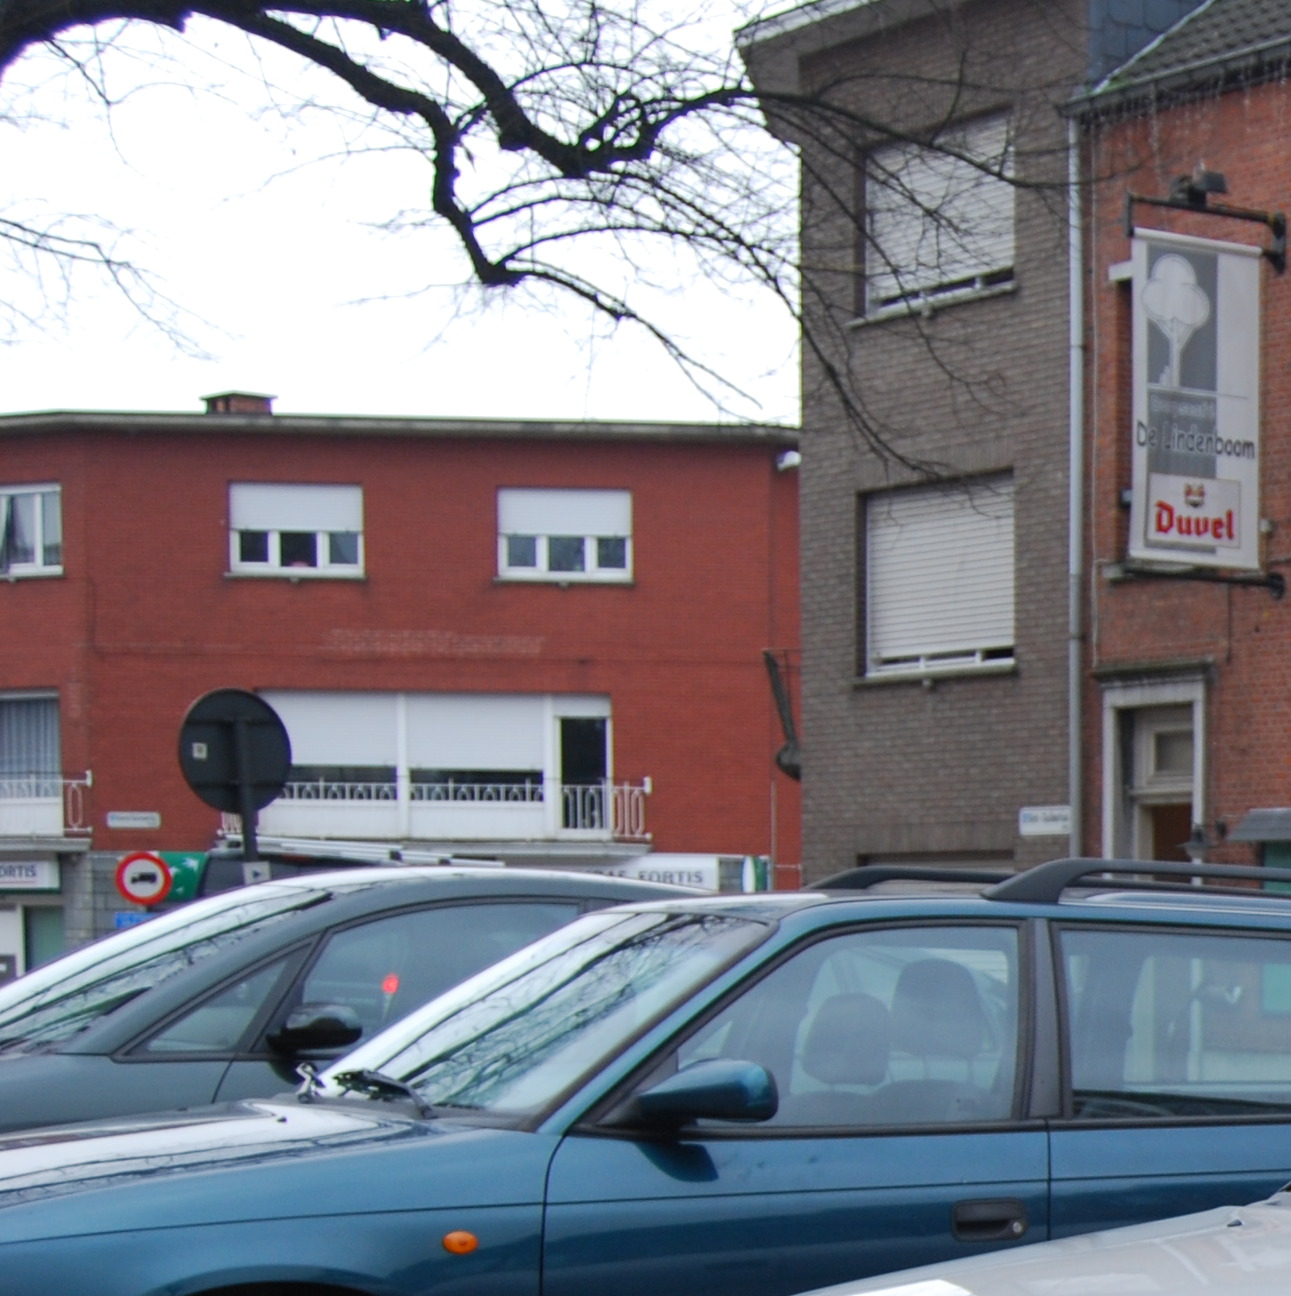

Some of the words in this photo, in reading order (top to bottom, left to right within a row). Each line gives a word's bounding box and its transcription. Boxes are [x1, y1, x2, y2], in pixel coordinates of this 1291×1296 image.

[1136, 420, 1157, 447] De
[1163, 422, 1256, 459] Lindenboom
[1155, 500, 1235, 540] Duvel
